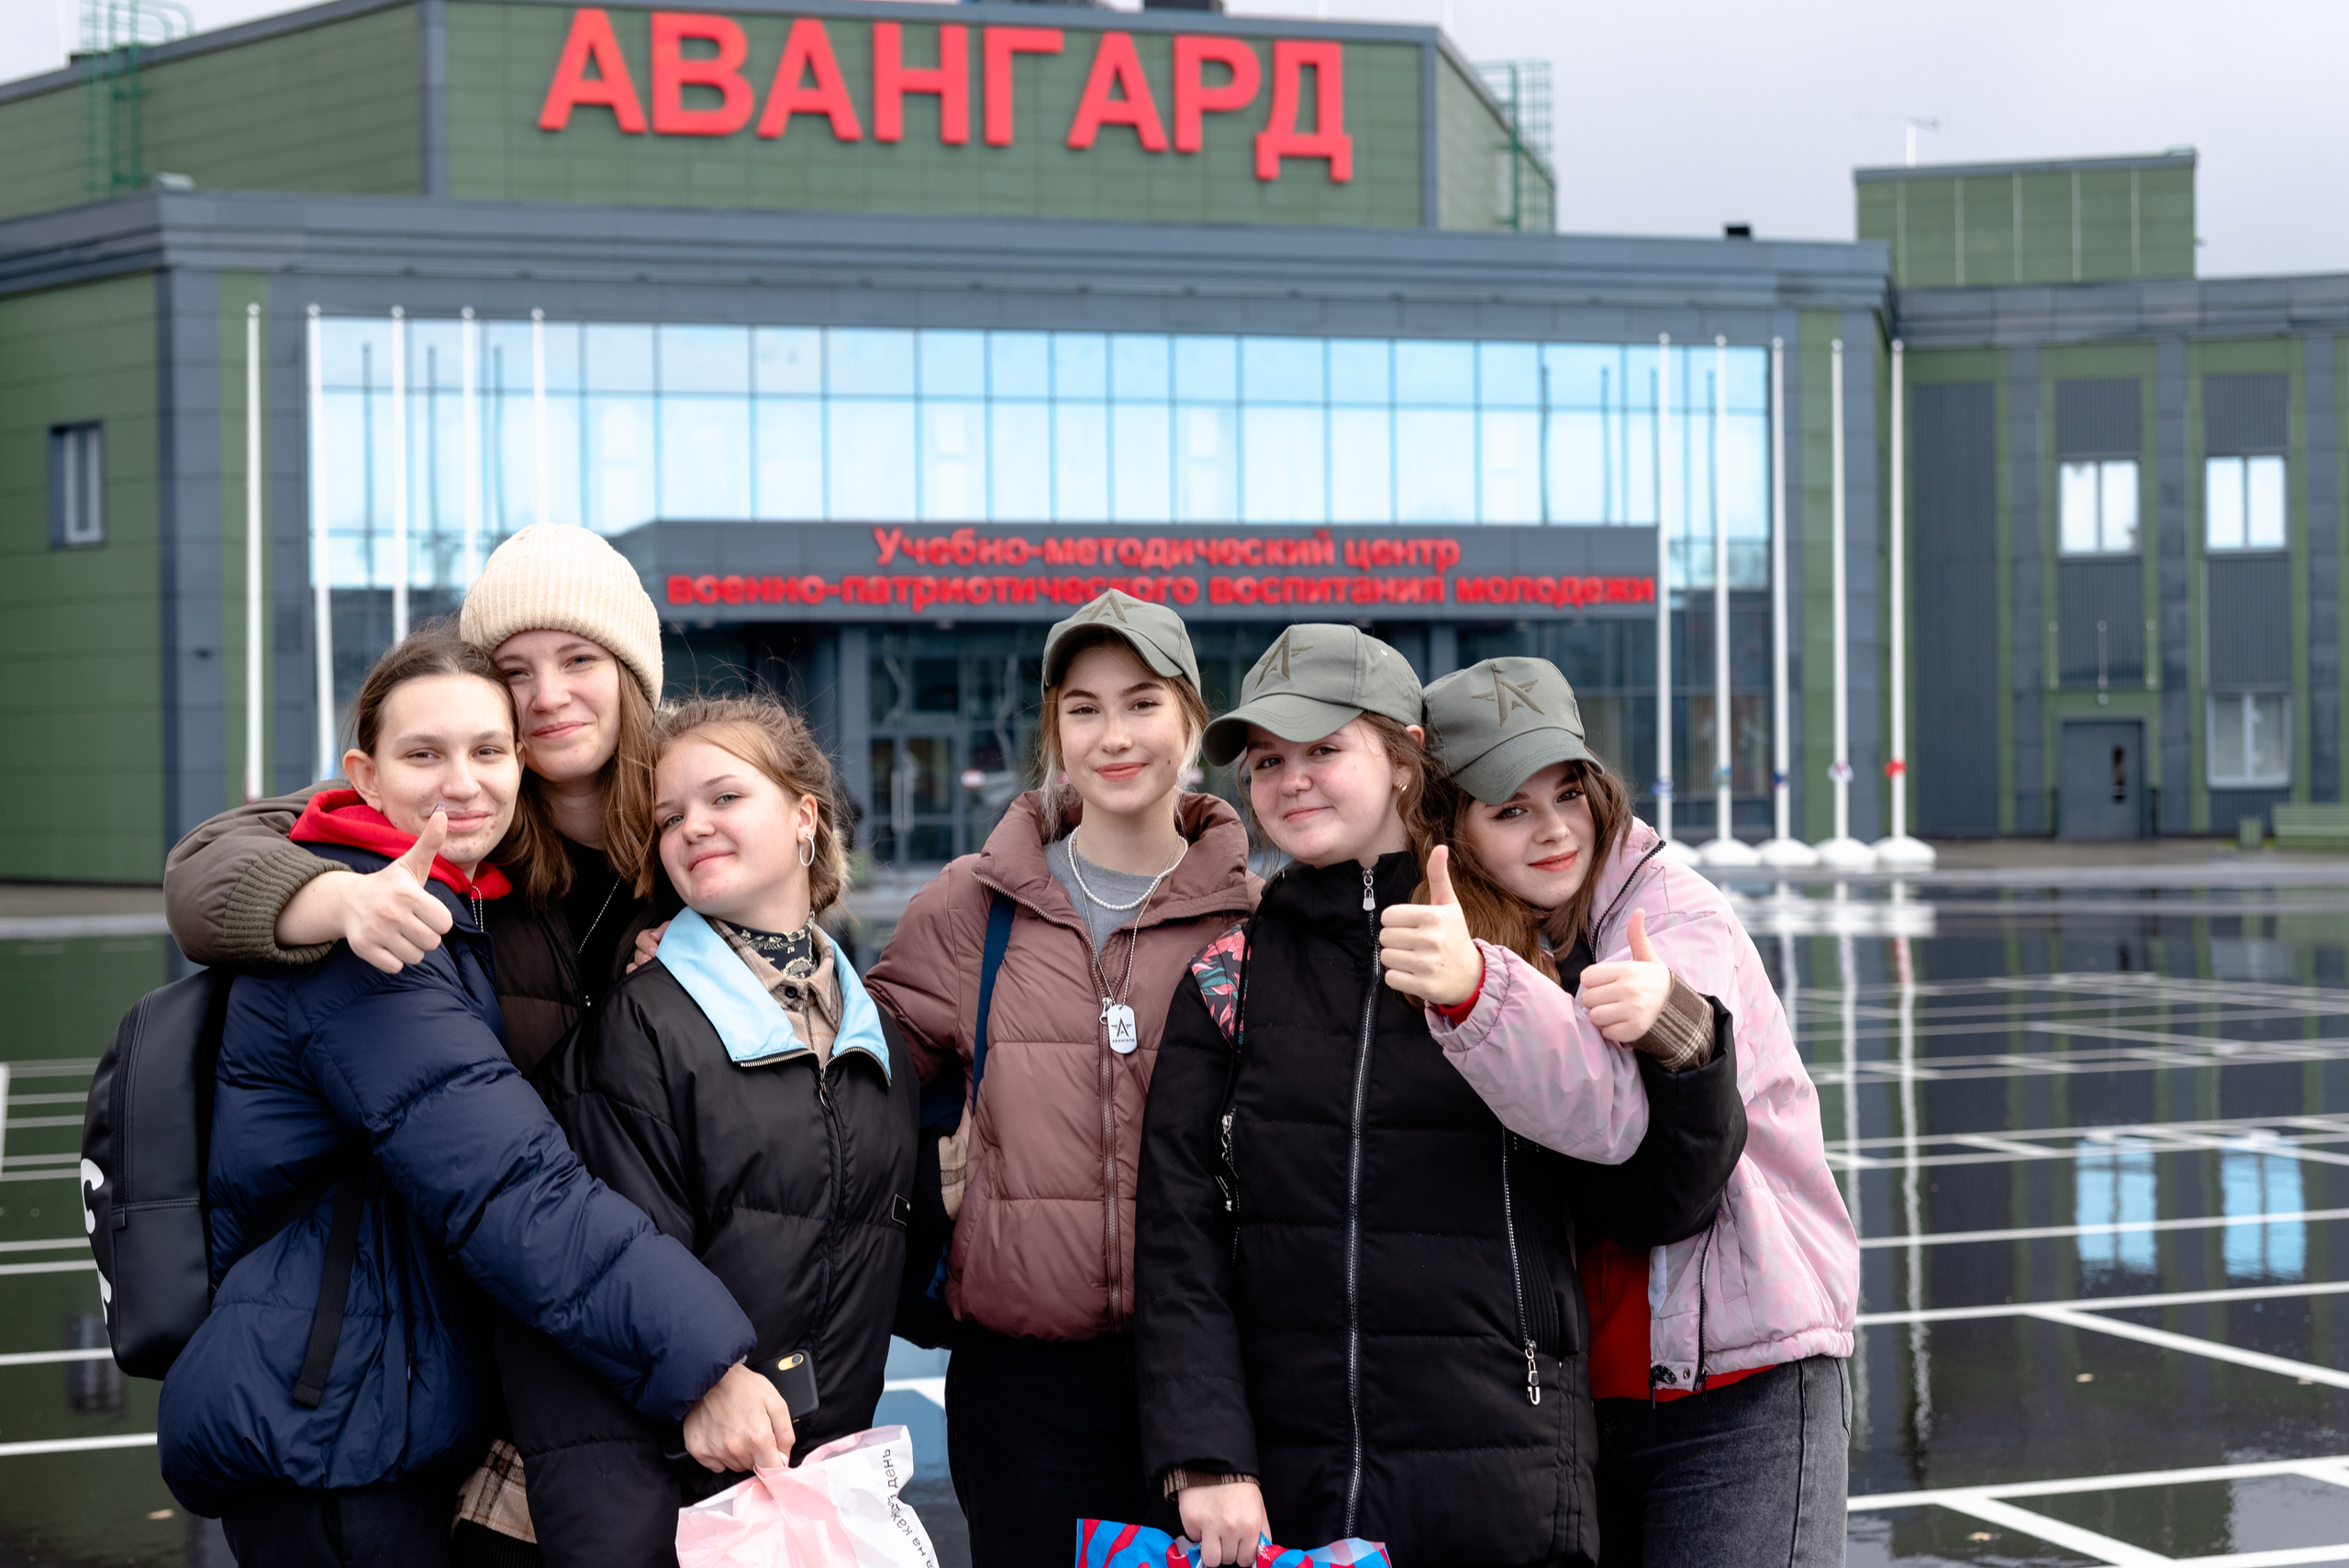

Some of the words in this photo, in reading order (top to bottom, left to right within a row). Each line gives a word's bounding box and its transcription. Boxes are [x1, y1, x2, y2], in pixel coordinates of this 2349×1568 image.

[539, 7, 1353, 183] АВАНГАРД
[874, 527, 1335, 571] Учебно-методический
[1344, 539, 1461, 573] центр
[1209, 576, 1446, 605] воспитания
[1455, 576, 1655, 608] молодежи
[882, 1449, 899, 1489] день
[912, 1538, 926, 1557] на
